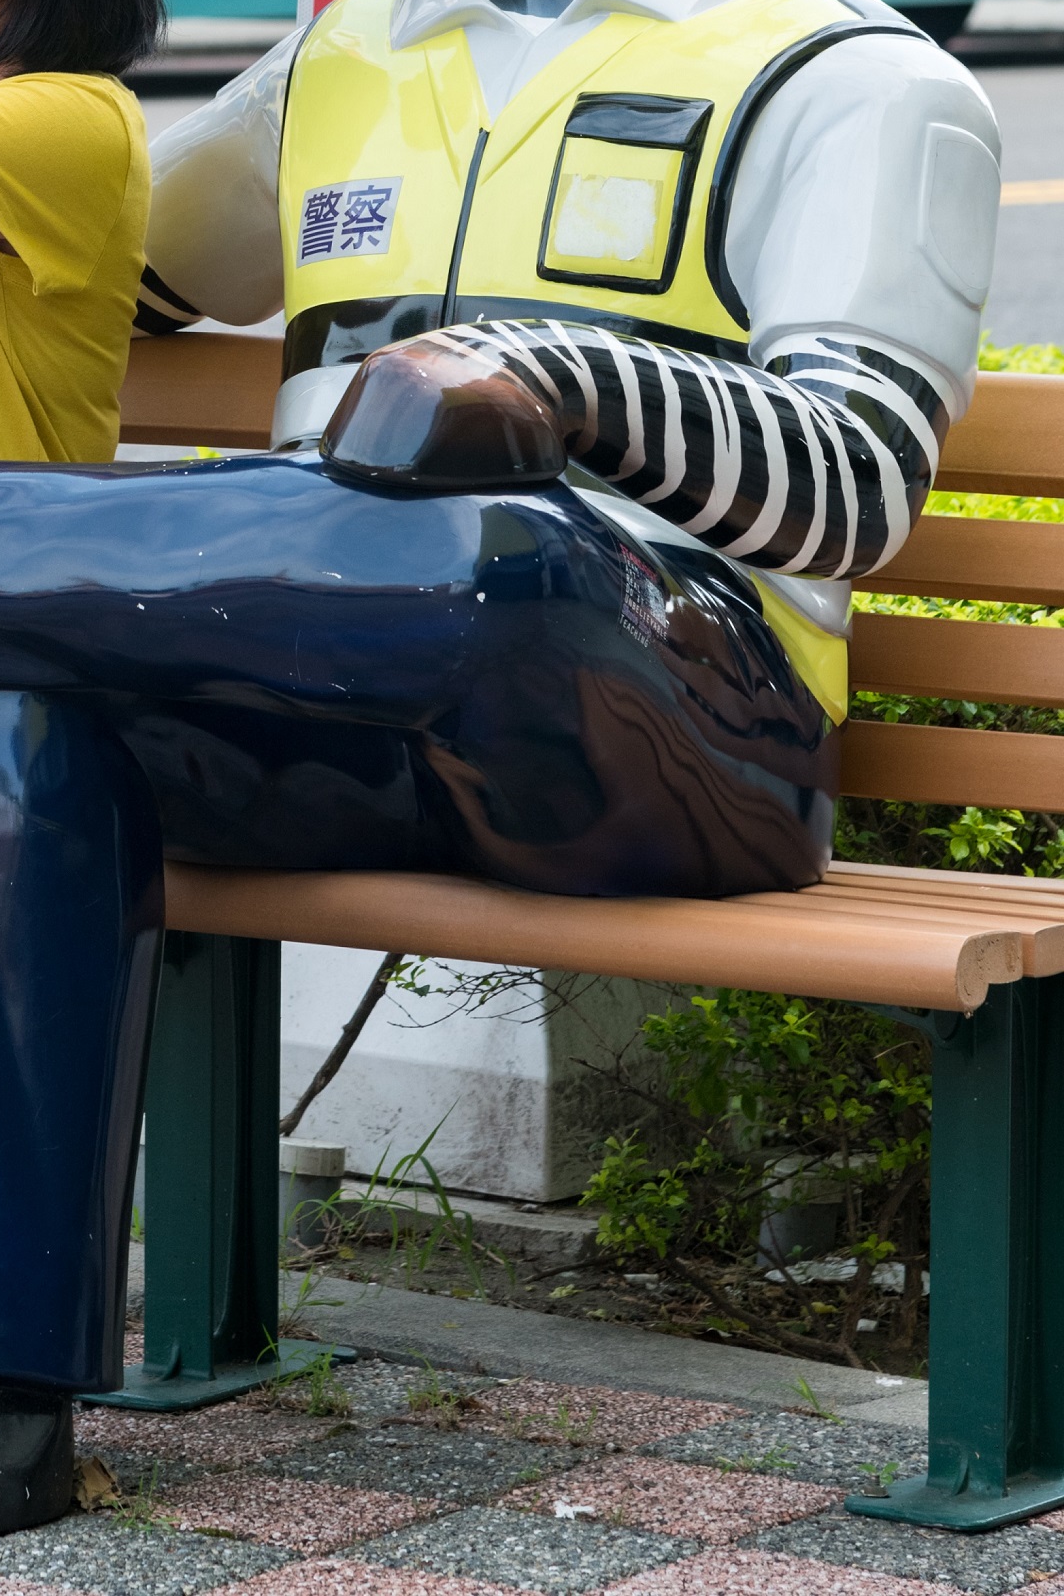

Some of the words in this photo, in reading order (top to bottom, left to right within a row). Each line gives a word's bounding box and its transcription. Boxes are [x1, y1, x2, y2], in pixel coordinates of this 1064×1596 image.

[301, 185, 393, 260] 警察
[620, 614, 649, 647] TEACHING
[624, 593, 668, 640] UNBELIEVABLE
